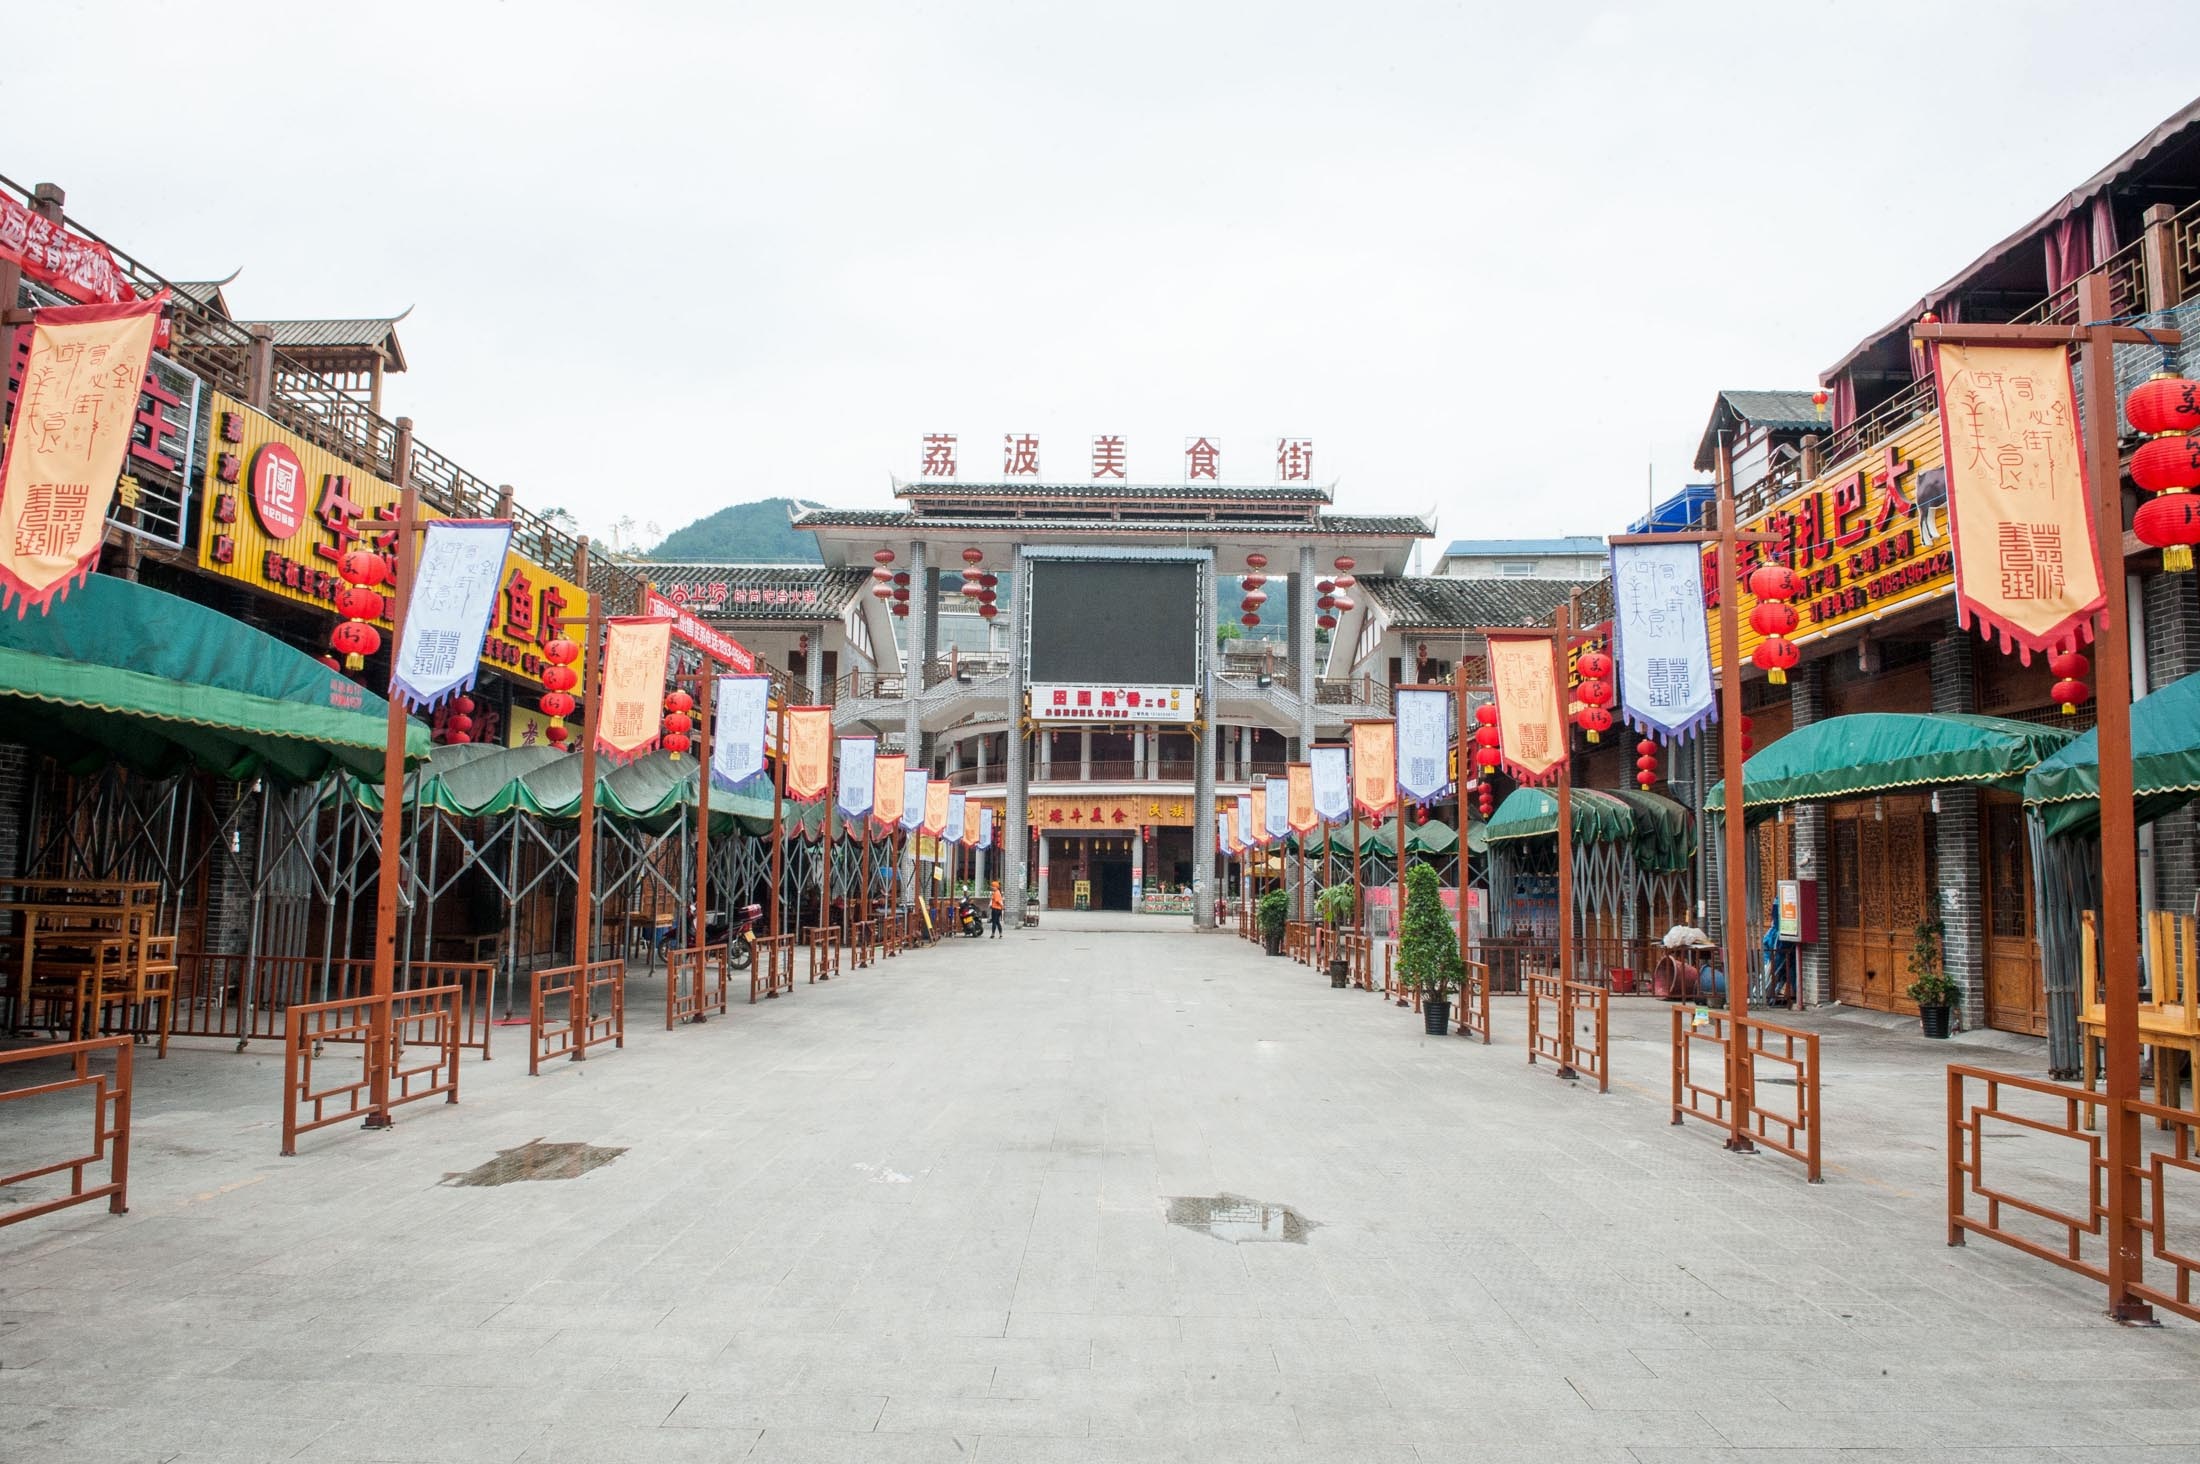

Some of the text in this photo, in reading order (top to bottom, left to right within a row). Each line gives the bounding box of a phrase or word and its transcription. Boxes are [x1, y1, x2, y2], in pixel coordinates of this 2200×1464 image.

[923, 433, 1312, 480] 荔波美食街
[118, 474, 140, 509] 香
[734, 590, 817, 604] 时尚吧台火锅
